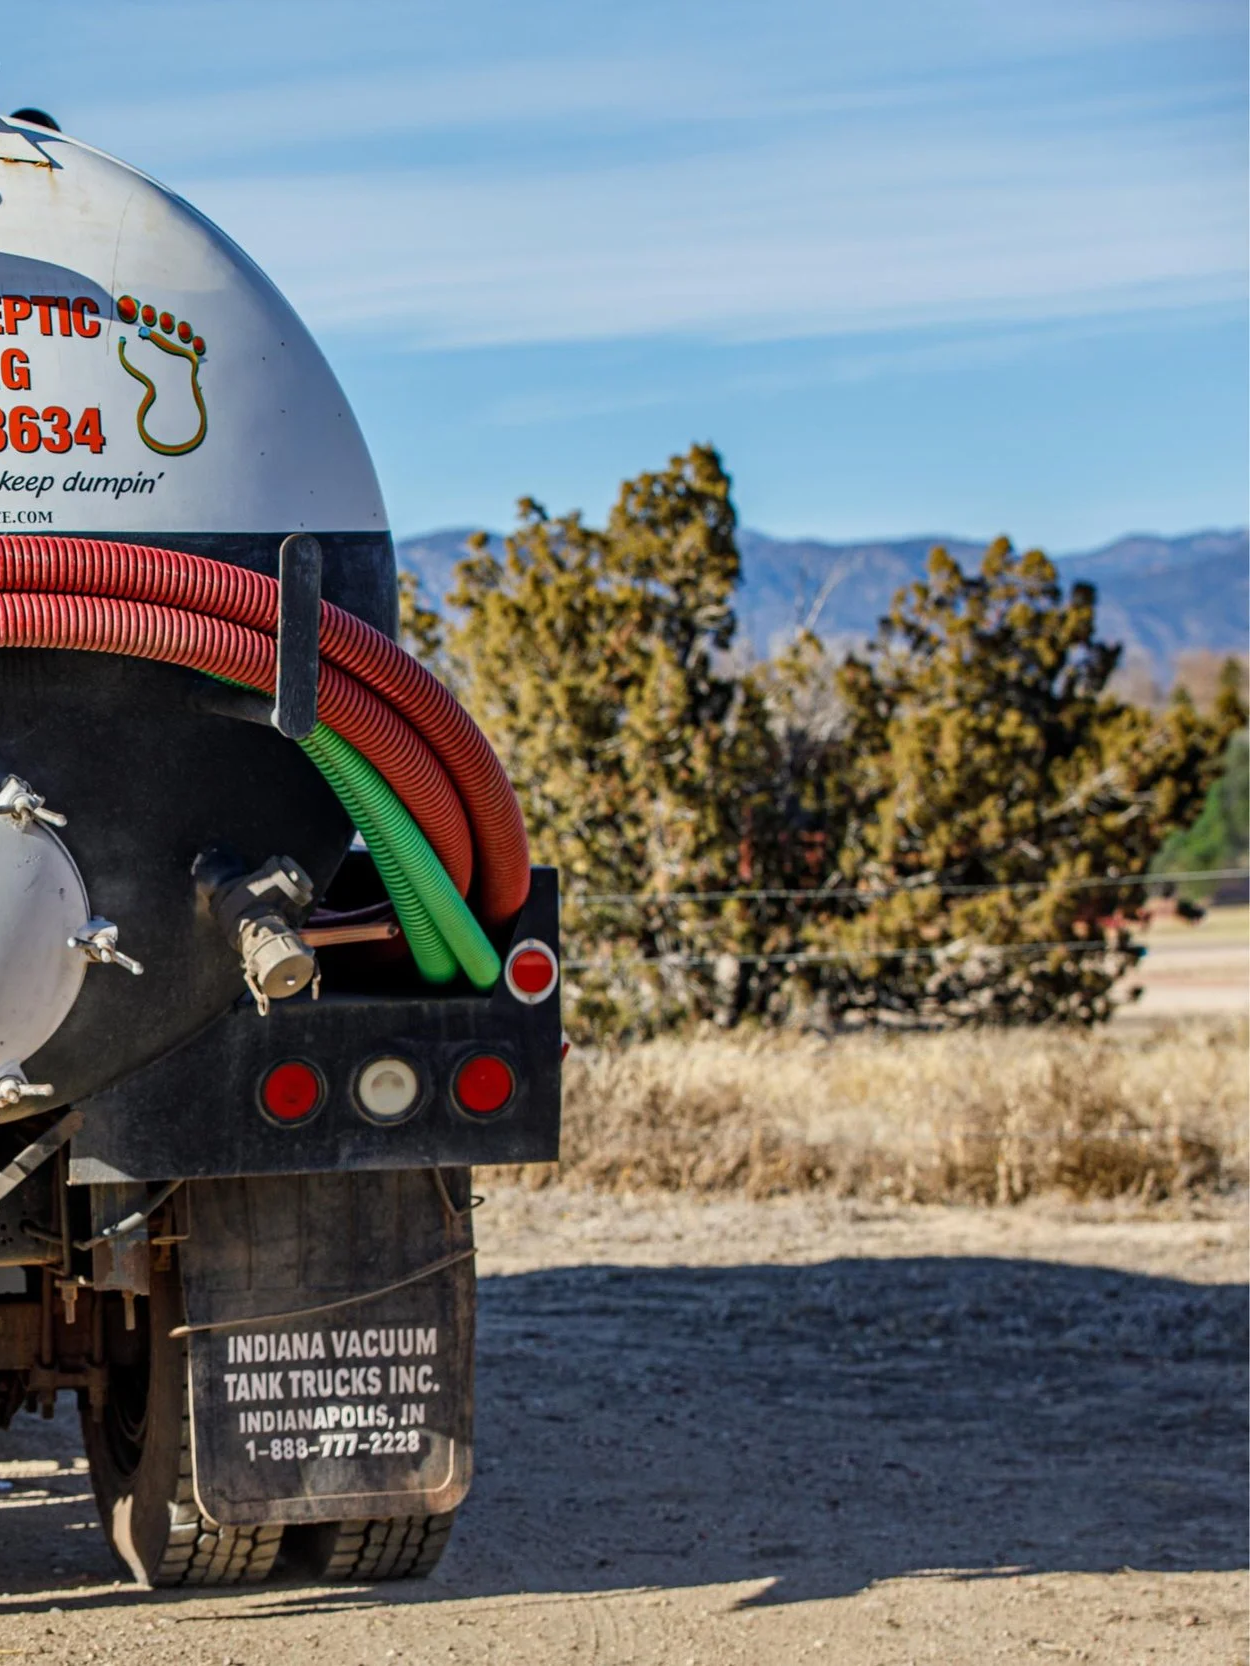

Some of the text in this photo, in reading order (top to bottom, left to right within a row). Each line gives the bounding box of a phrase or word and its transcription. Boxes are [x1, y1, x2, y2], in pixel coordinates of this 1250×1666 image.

[228, 1328, 437, 1363] INDIANA VACUUM
[224, 1365, 440, 1402] TANK TRUCKS INC.
[239, 1403, 425, 1433] INDIANAPOLIS, IN
